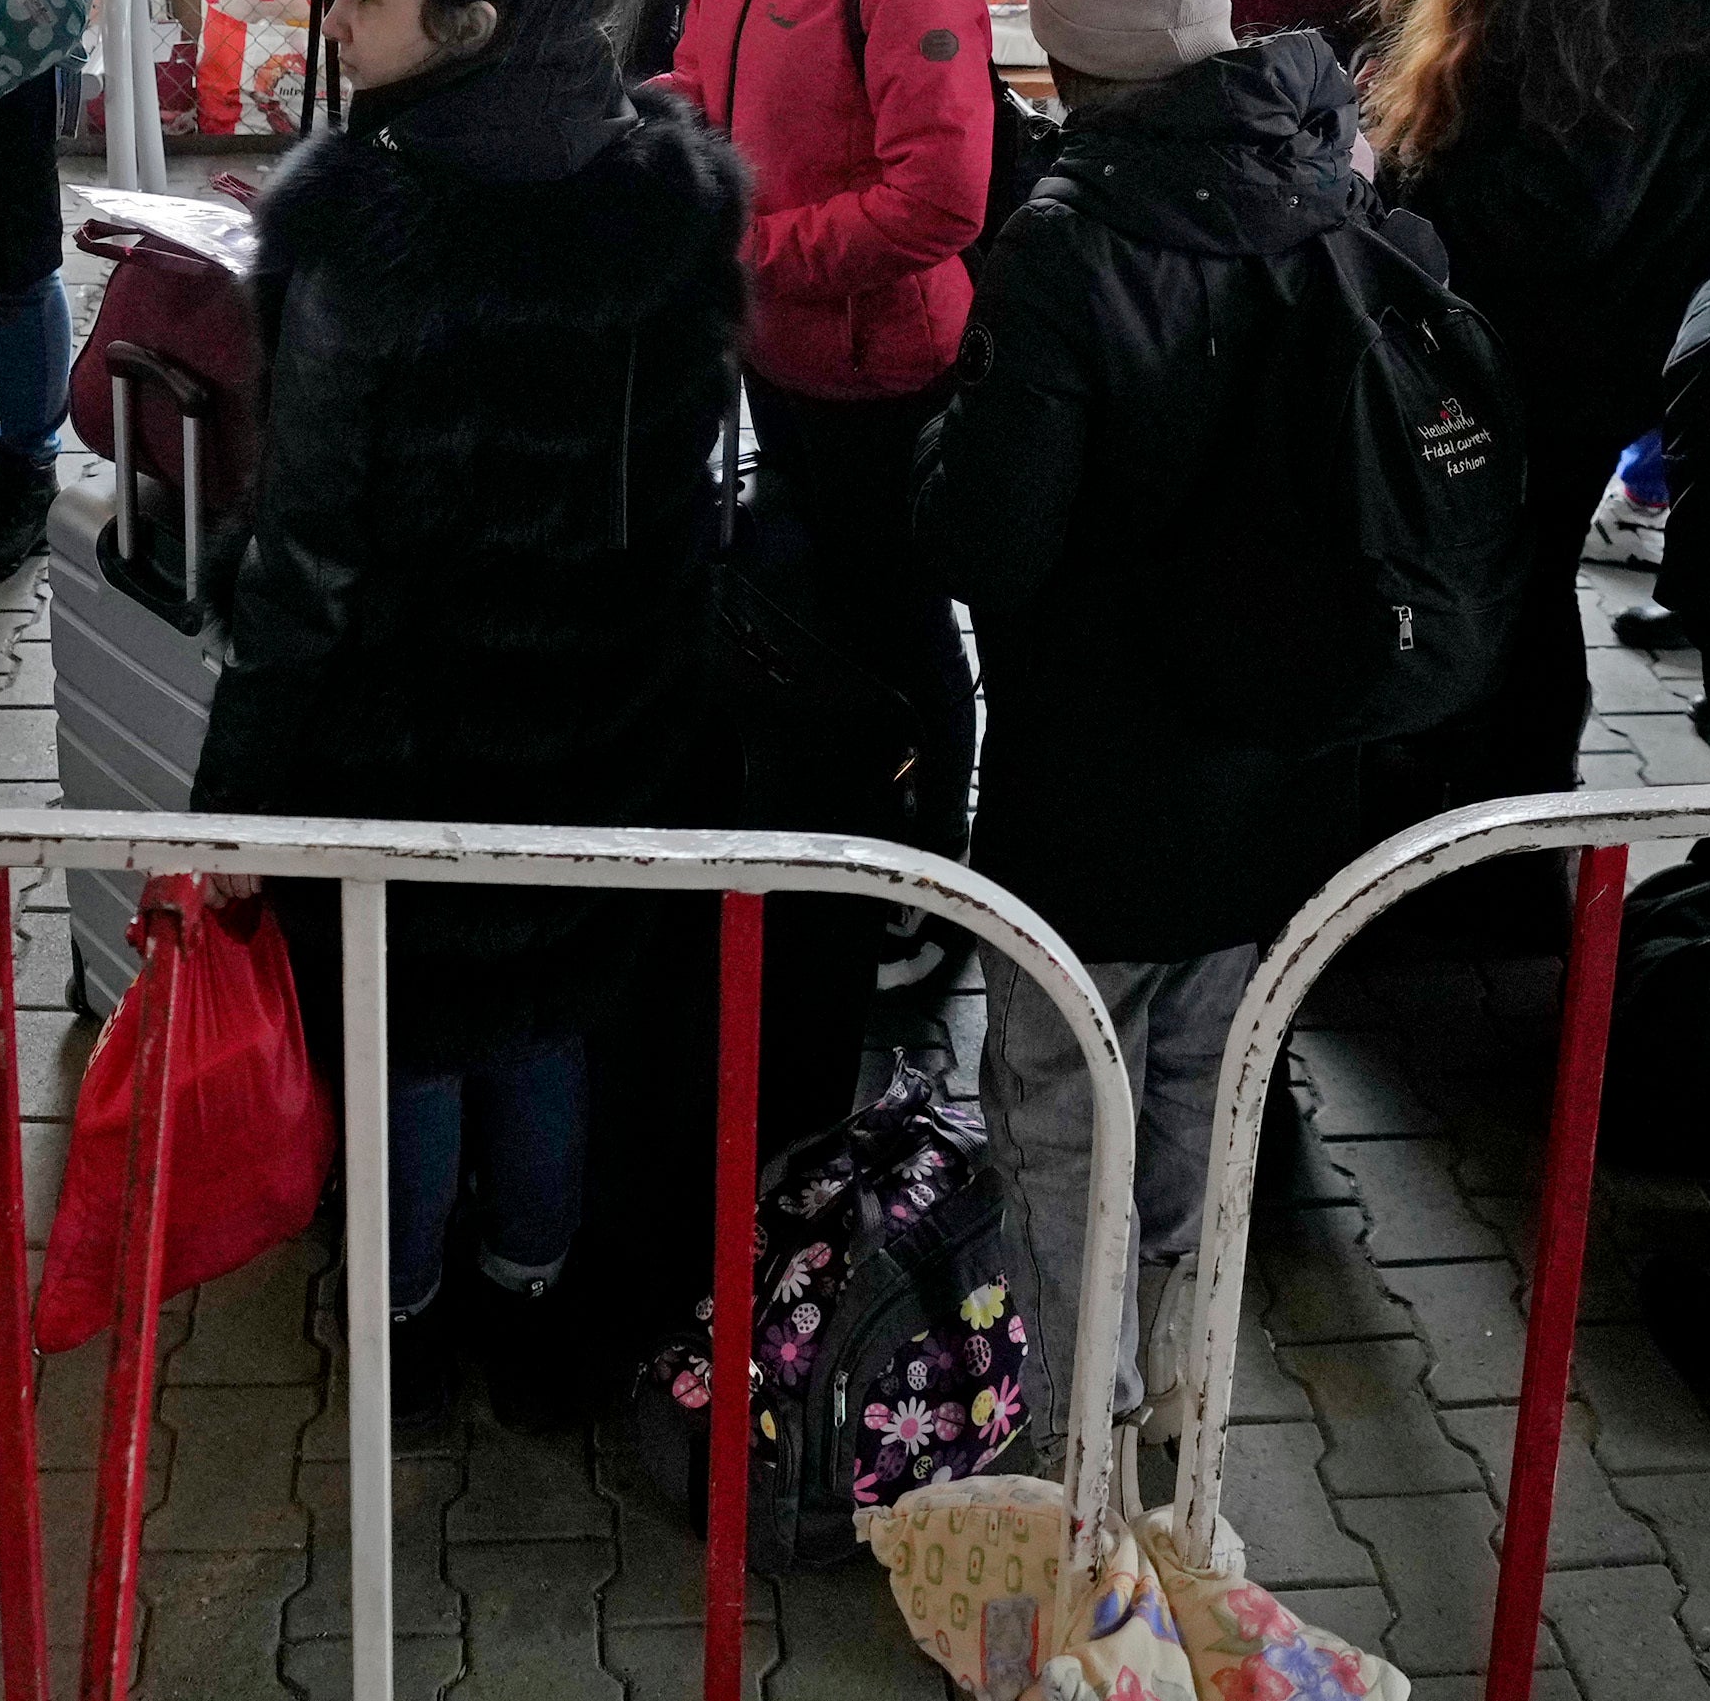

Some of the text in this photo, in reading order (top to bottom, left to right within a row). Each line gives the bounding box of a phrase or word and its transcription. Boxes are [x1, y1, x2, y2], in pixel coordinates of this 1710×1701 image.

[1421, 428, 1491, 461] tidal current
[1447, 455, 1485, 477] fashion
